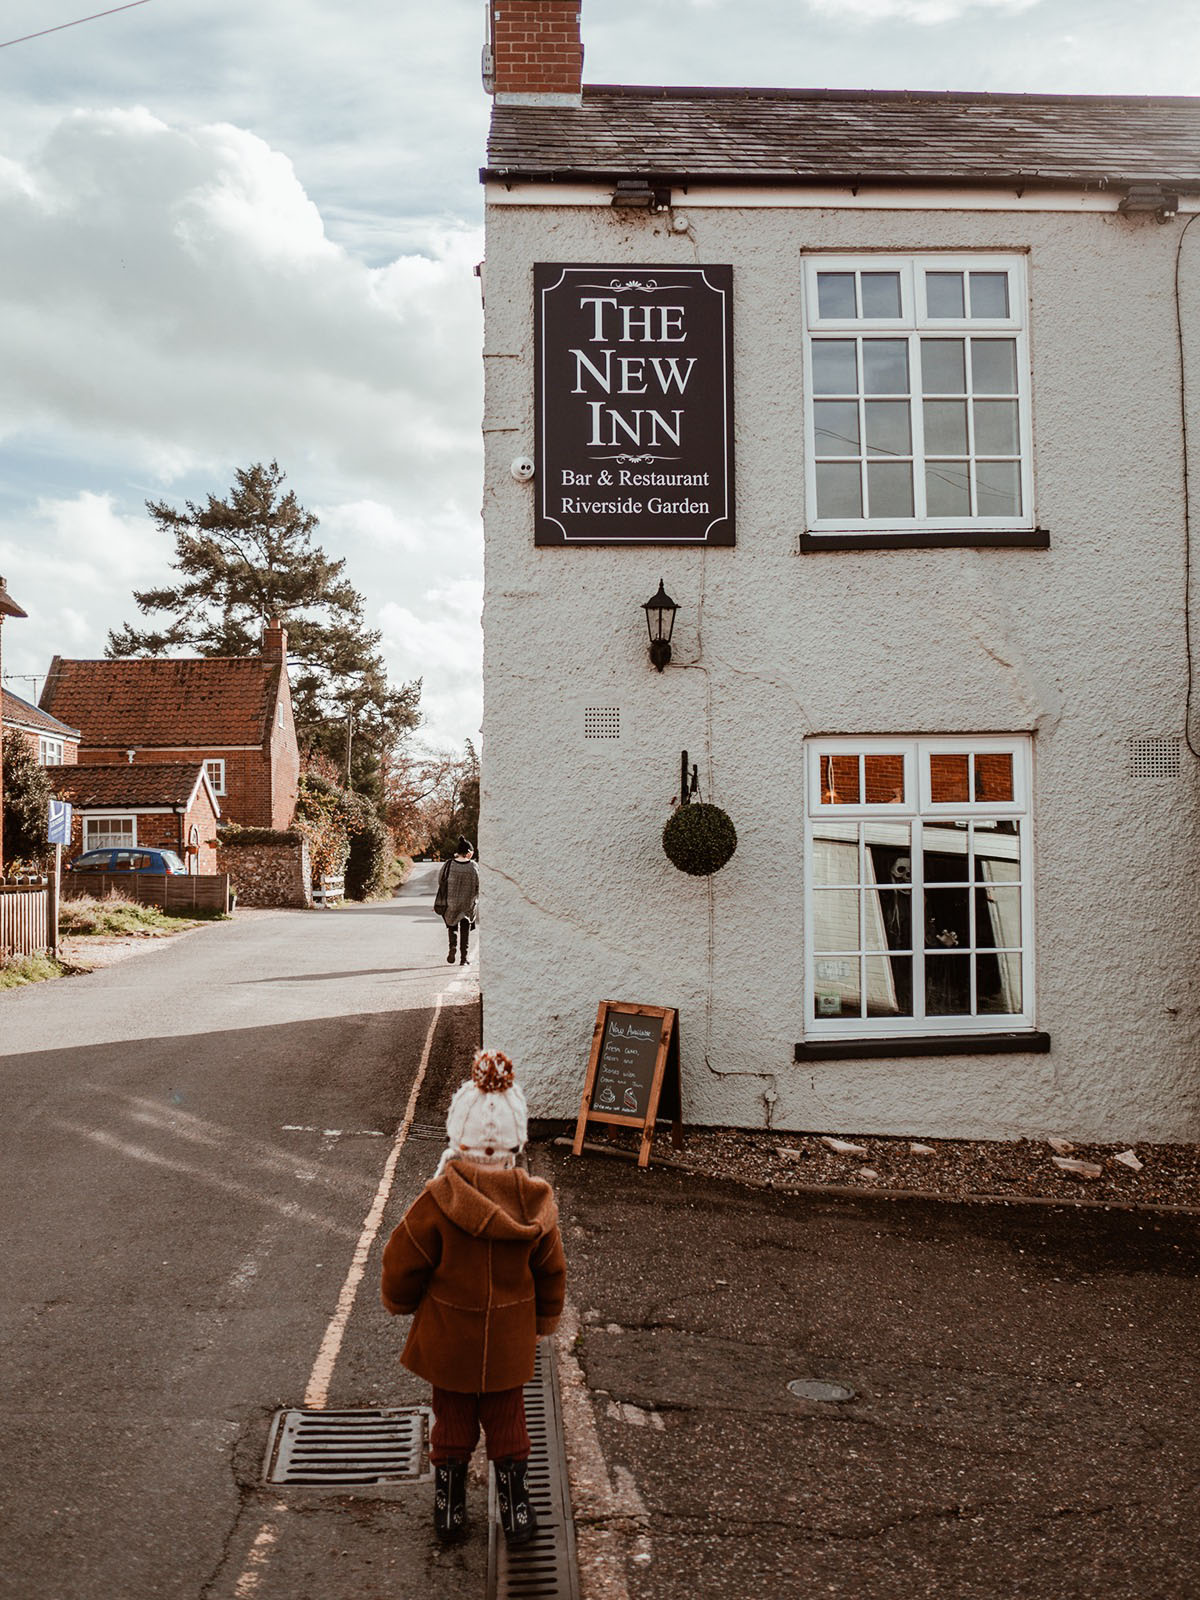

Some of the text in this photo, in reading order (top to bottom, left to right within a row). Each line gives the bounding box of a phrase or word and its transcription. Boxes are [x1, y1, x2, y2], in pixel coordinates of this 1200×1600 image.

[580, 297, 688, 343] THE
[568, 349, 698, 395] NEW
[586, 401, 685, 447] INN
[561, 470, 710, 486] Bar & Restaurant
[561, 497, 710, 514] Riverside Garden
